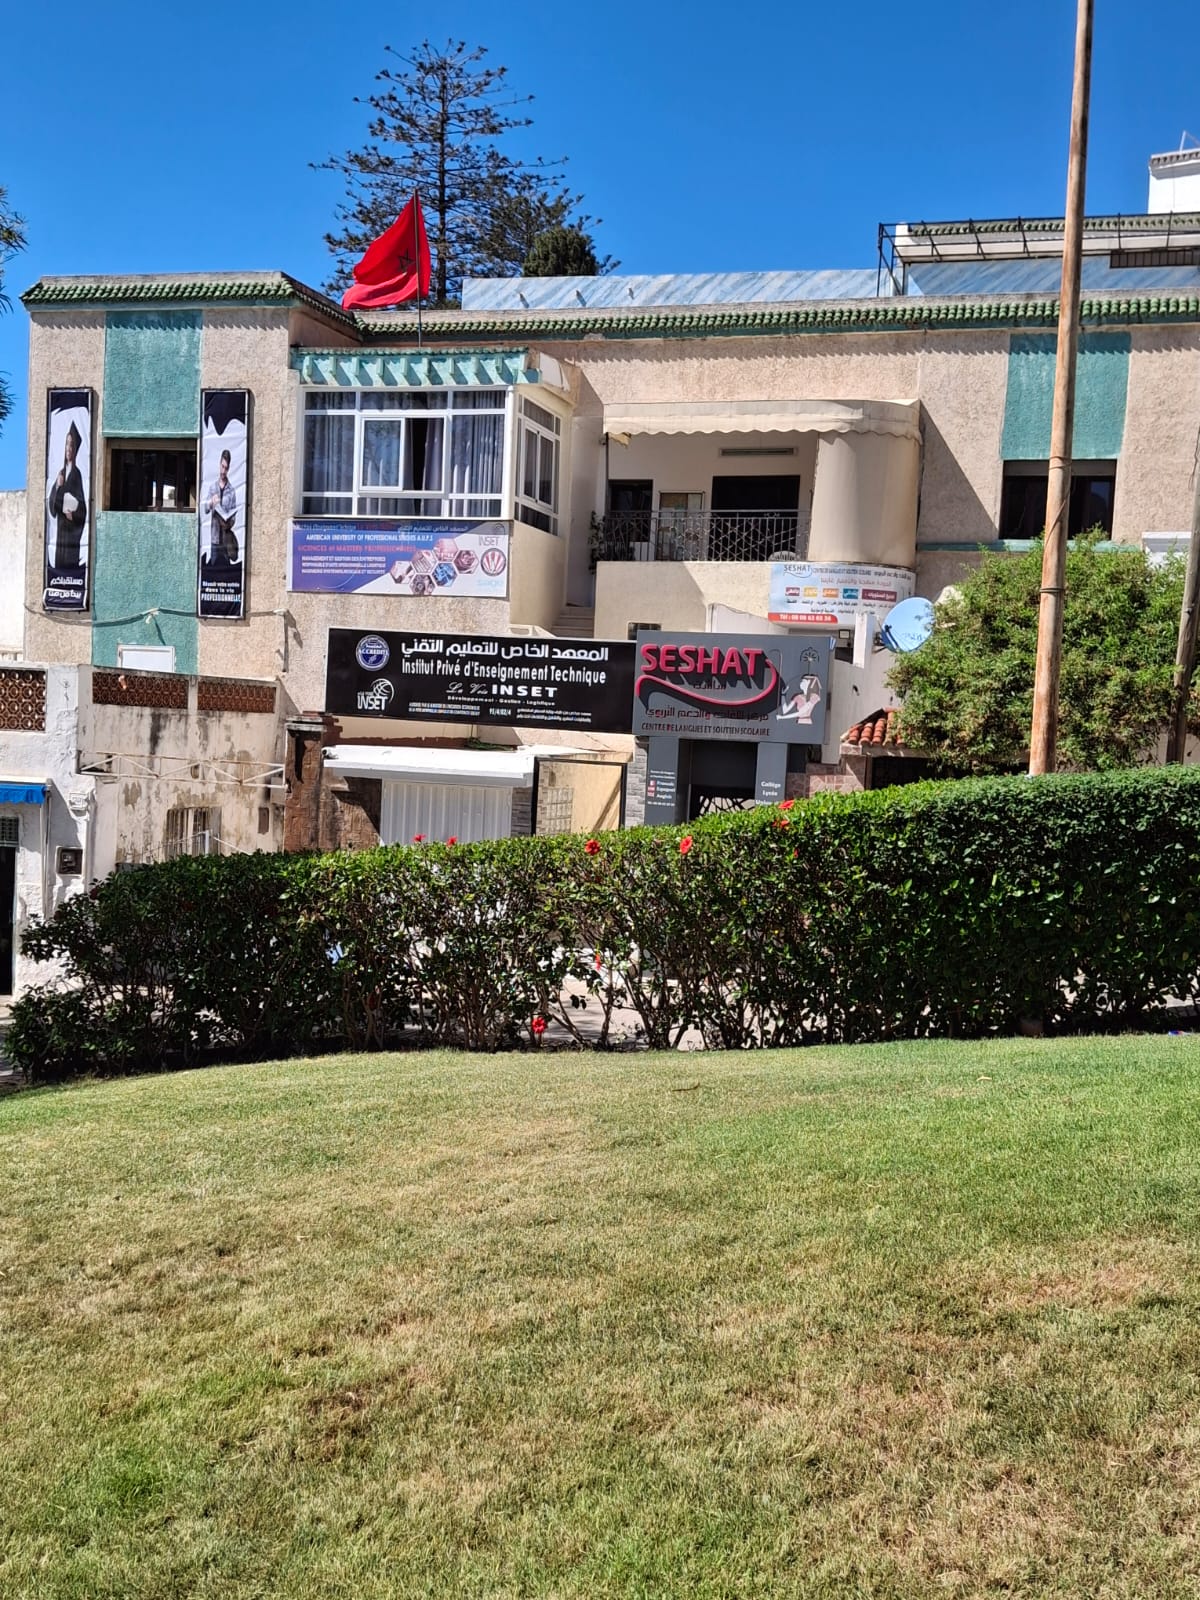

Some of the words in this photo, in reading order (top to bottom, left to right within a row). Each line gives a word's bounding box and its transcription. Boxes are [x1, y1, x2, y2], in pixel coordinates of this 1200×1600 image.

[365, 534, 398, 542] PROFESSIONAL
[783, 564, 811, 572] SESHAT
[401, 638, 444, 658] التقني
[445, 640, 499, 657] للتعليم
[501, 643, 549, 660] الخاص
[552, 647, 609, 661] المعهد
[640, 643, 763, 676] SESHAT
[401, 658, 434, 675] Institut
[436, 658, 461, 676] Privé
[463, 660, 548, 682] d'Enseignement
[550, 664, 607, 687] Technique
[491, 683, 558, 698] INSET
[447, 695, 494, 703] Développement
[498, 697, 521, 705] Gestion
[526, 699, 556, 707] Logistique
[641, 722, 666, 731] CENTRE
[666, 723, 675, 732] DE
[675, 723, 704, 733] LANGUES
[704, 725, 712, 733] ET
[712, 725, 740, 735] SOUTIEN
[740, 726, 770, 736] SCOLAIRE
[760, 781, 782, 789] Collège
